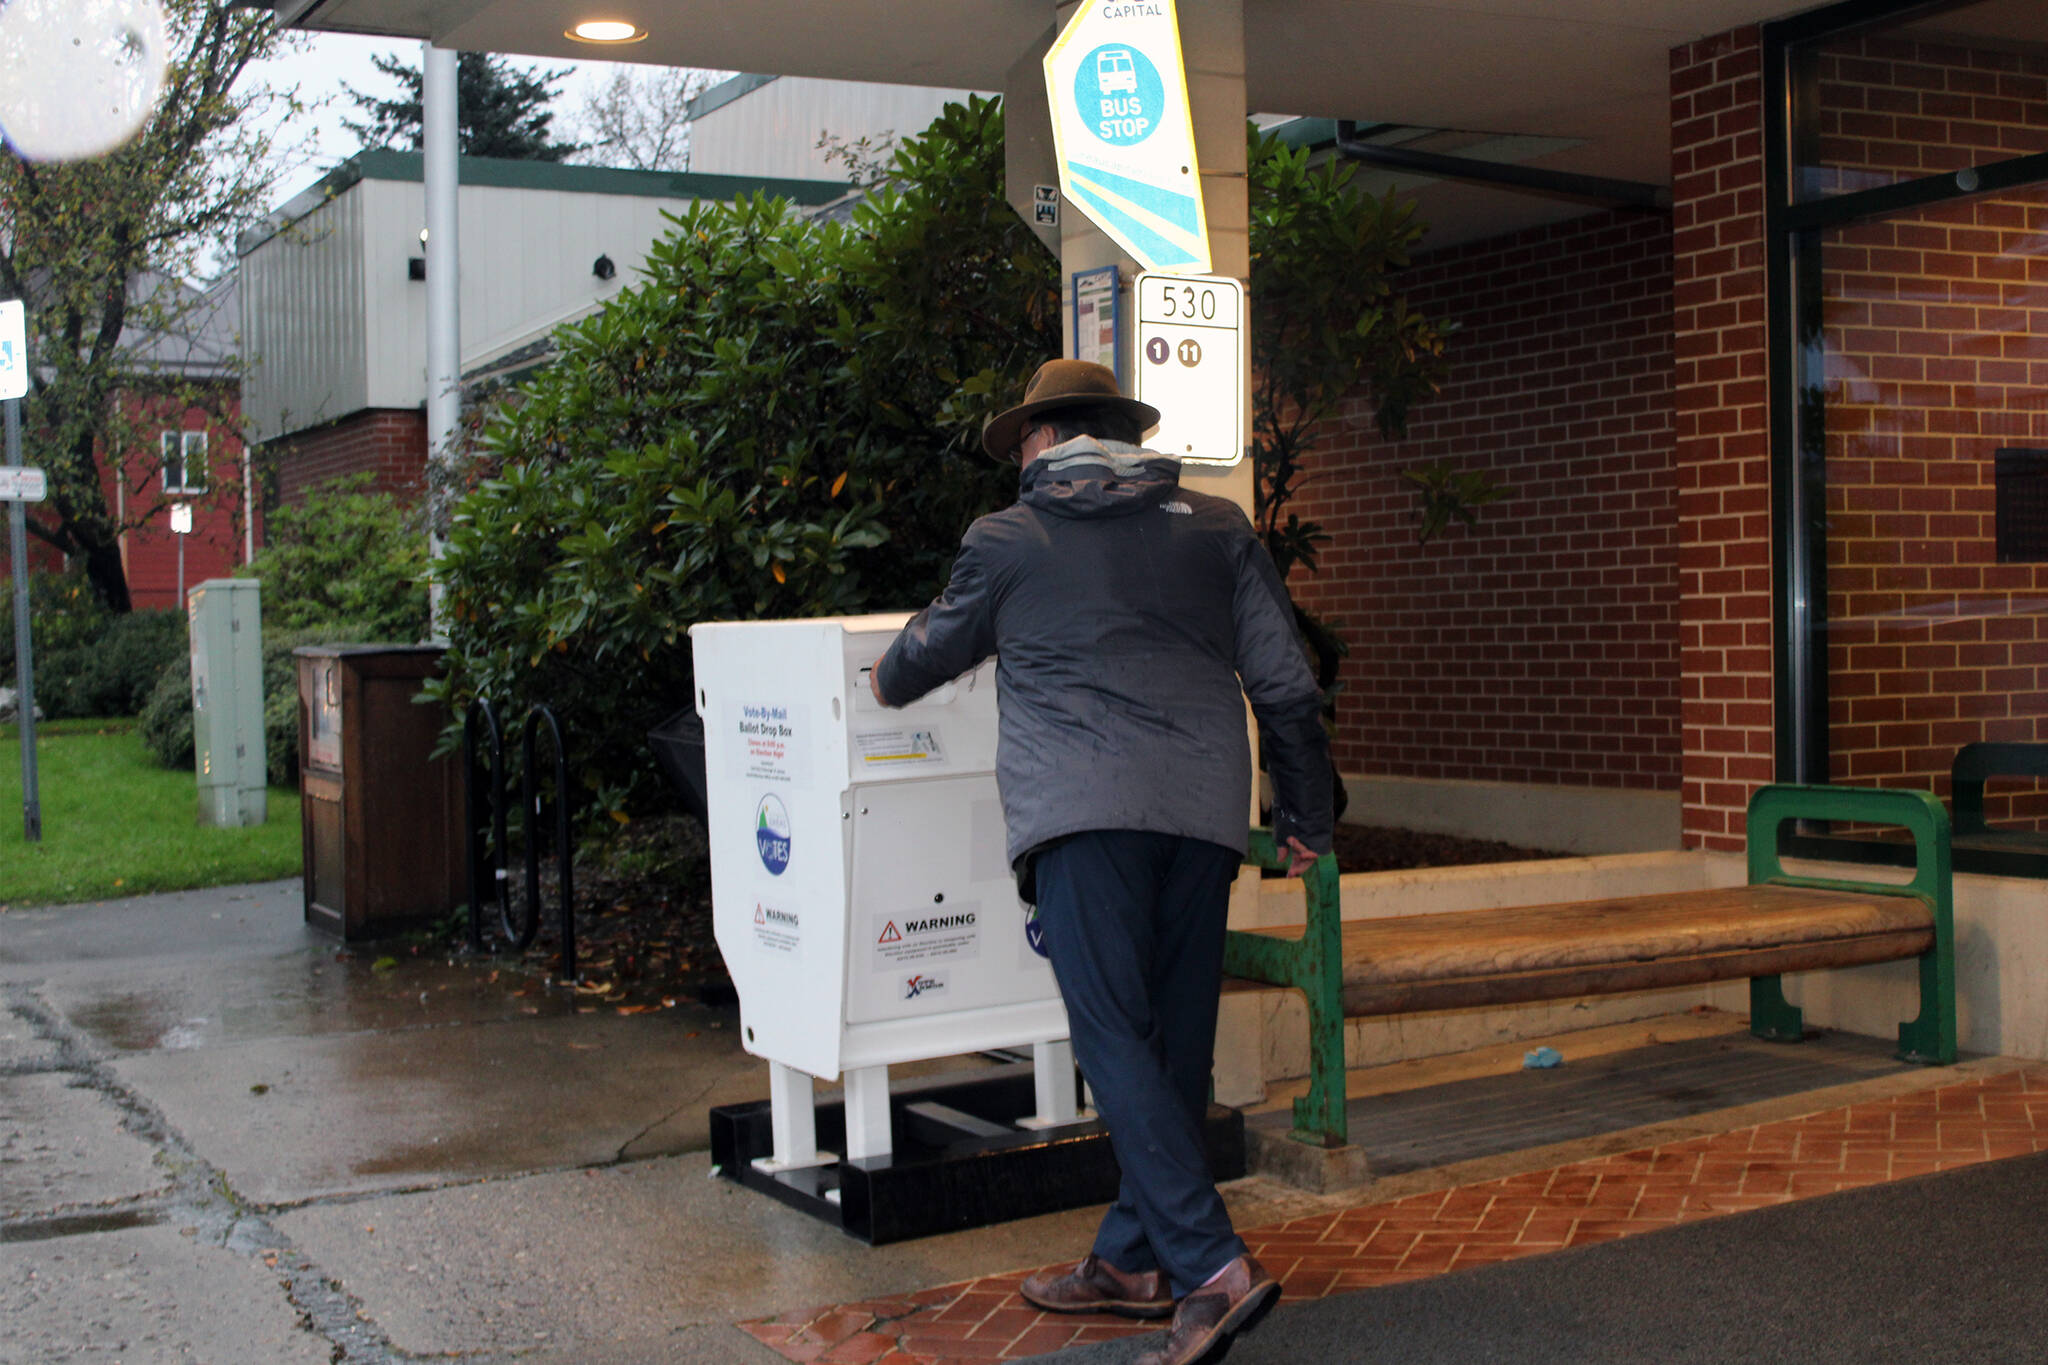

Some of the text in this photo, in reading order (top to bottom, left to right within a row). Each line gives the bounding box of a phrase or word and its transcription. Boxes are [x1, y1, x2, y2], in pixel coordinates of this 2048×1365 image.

[1103, 4, 1162, 19] CAPITAL
[1101, 97, 1142, 117] BUS
[1100, 118, 1149, 139] STOP
[1163, 286, 1216, 320] 530
[1152, 342, 1199, 362] 1 11
[739, 721, 792, 738] Ballot Drop Box
[766, 908, 799, 927] WARNING
[905, 913, 976, 933] WARNING
